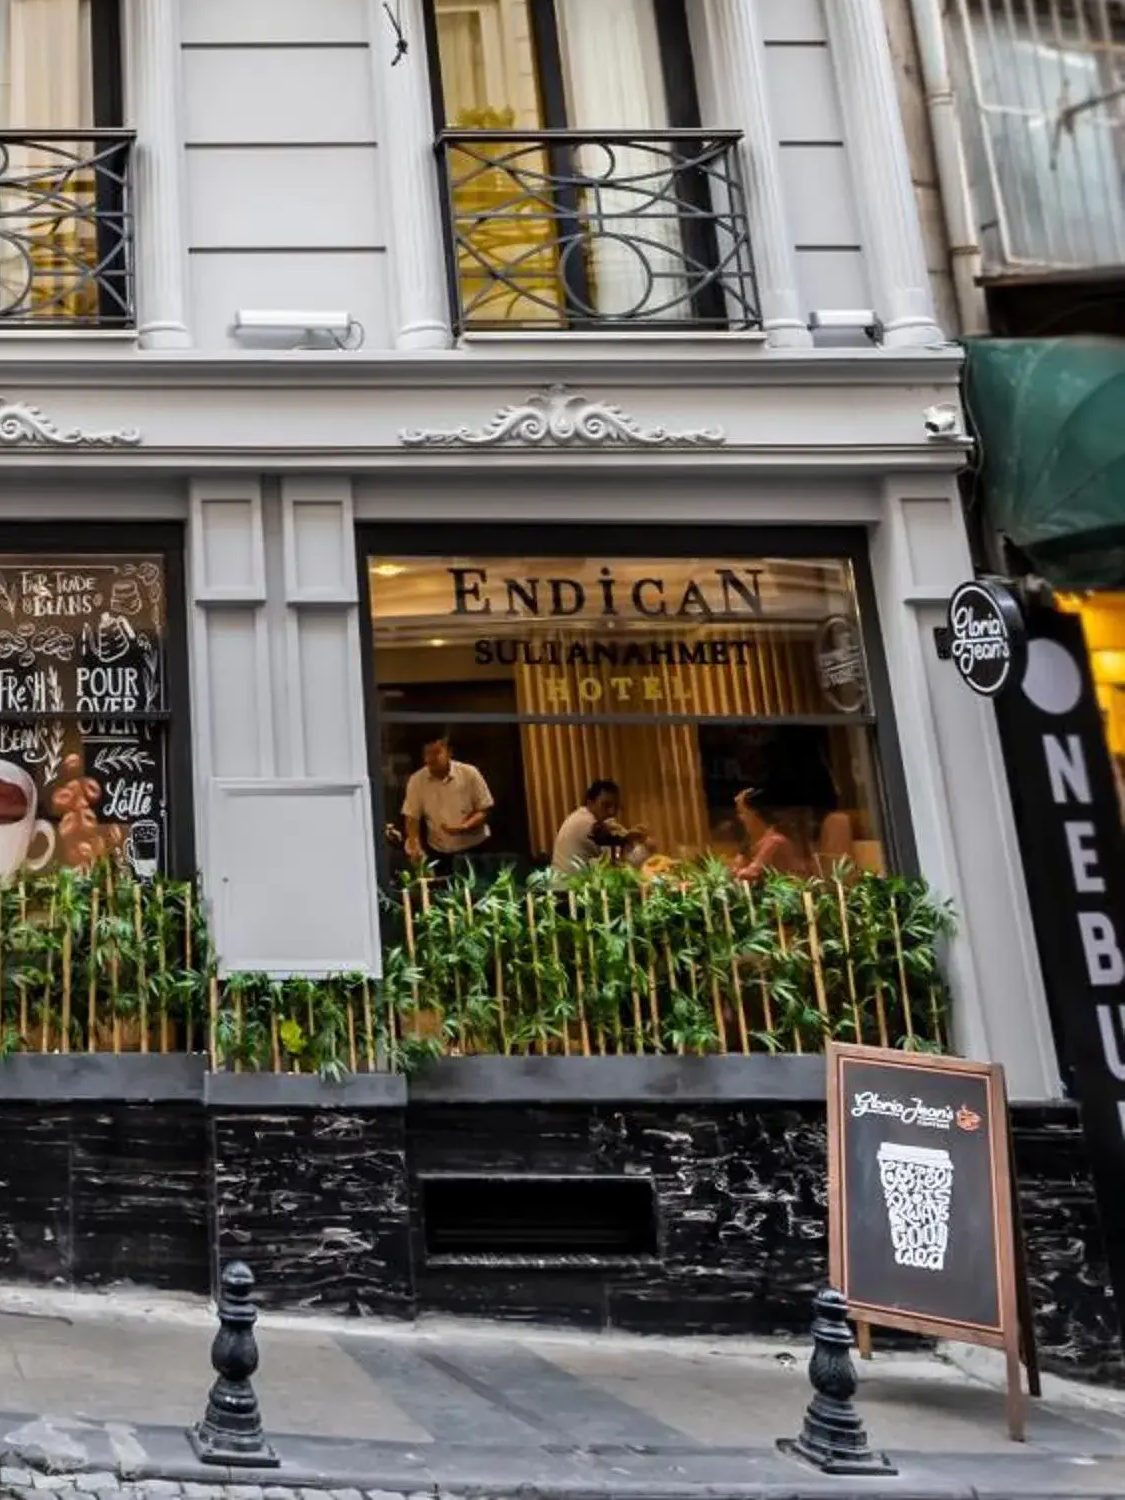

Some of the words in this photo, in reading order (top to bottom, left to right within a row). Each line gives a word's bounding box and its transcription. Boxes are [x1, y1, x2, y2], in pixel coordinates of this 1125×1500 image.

[475, 639, 753, 666] SULTANAHMET
[76, 666, 139, 697] POUR
[546, 676, 694, 702] HOTEL
[76, 697, 139, 735] OVER
